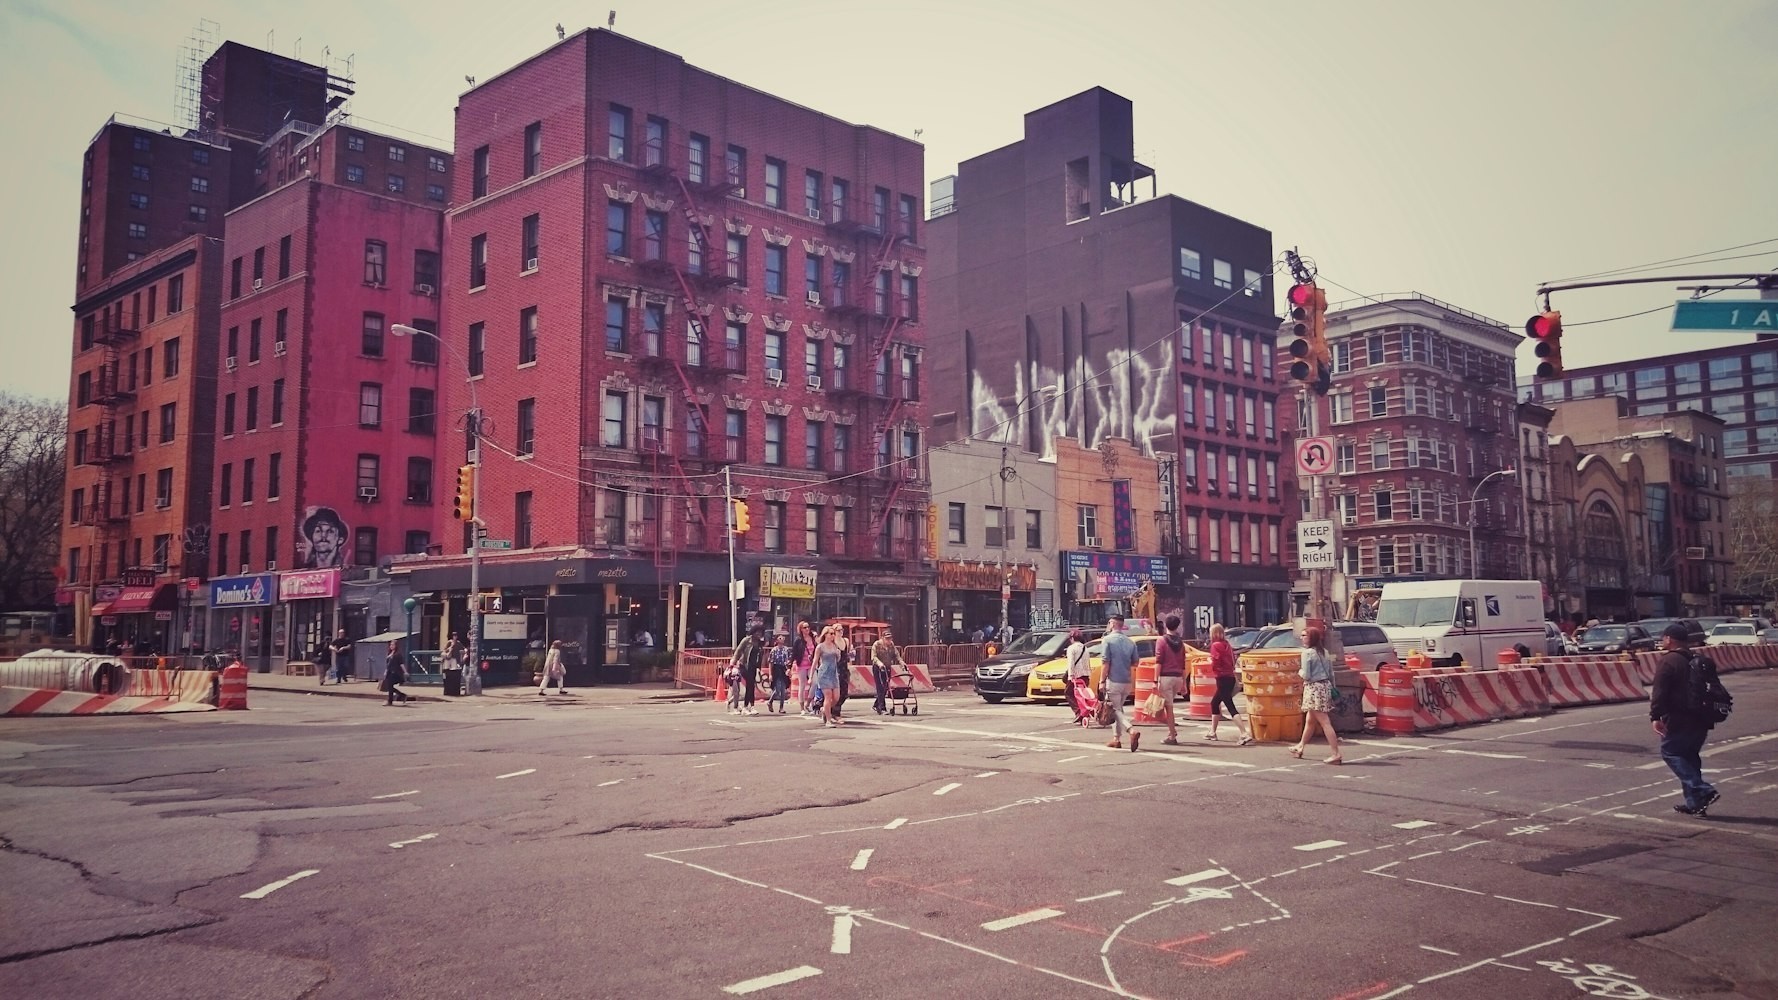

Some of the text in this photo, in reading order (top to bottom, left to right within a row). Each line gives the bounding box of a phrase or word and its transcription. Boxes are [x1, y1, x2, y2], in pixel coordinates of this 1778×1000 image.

[1731, 309, 1778, 326] 1 A
[928, 505, 937, 559] COPIES
[1303, 526, 1330, 537] KEEP
[1302, 552, 1332, 563] RIGHT
[555, 567, 577, 577] mezetto
[597, 566, 628, 577] mezetto
[127, 576, 153, 585] DELI
[216, 585, 251, 604] Domino's
[1193, 605, 1215, 629] 151
